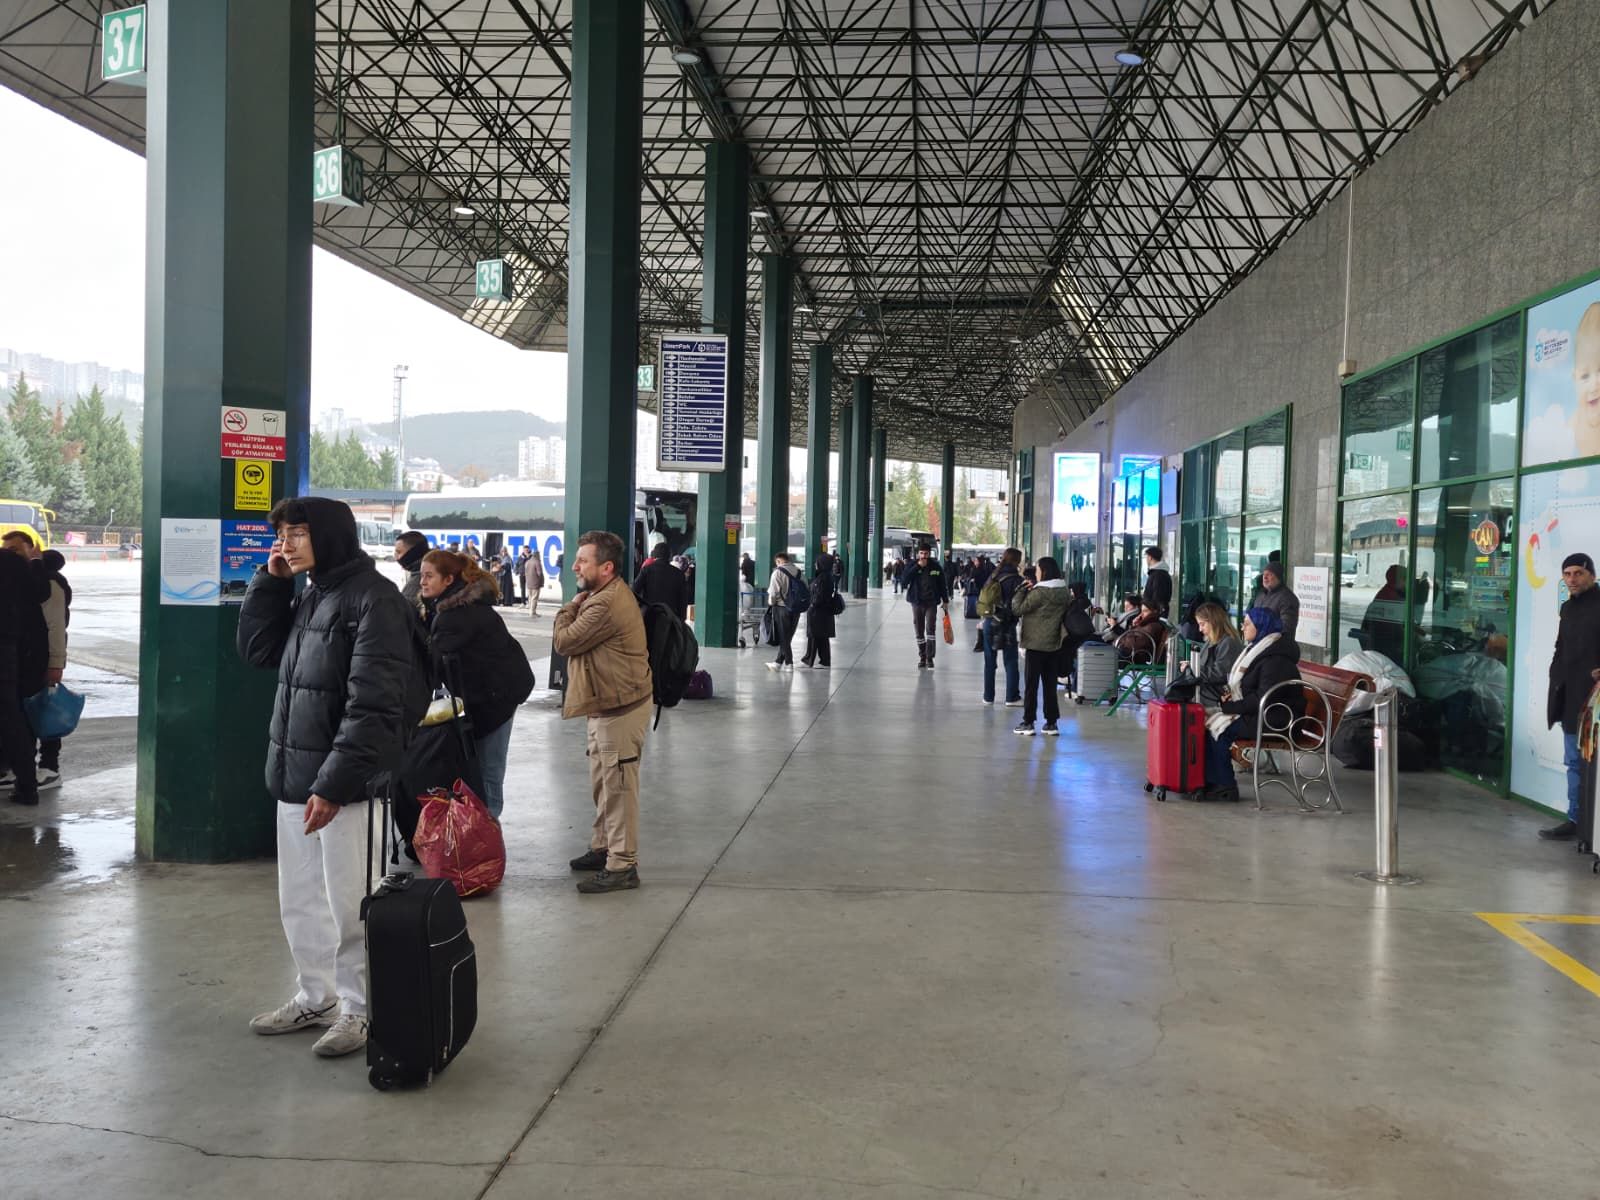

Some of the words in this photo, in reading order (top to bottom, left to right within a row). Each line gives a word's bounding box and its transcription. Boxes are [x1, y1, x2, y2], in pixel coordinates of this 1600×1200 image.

[108, 13, 142, 71] 37
[316, 152, 339, 195] 36
[344, 154, 363, 200] 36
[480, 263, 500, 293] 35
[638, 368, 651, 386] 33
[231, 449, 244, 457] ÇÖP
[245, 450, 277, 458] ATMAYINIZ
